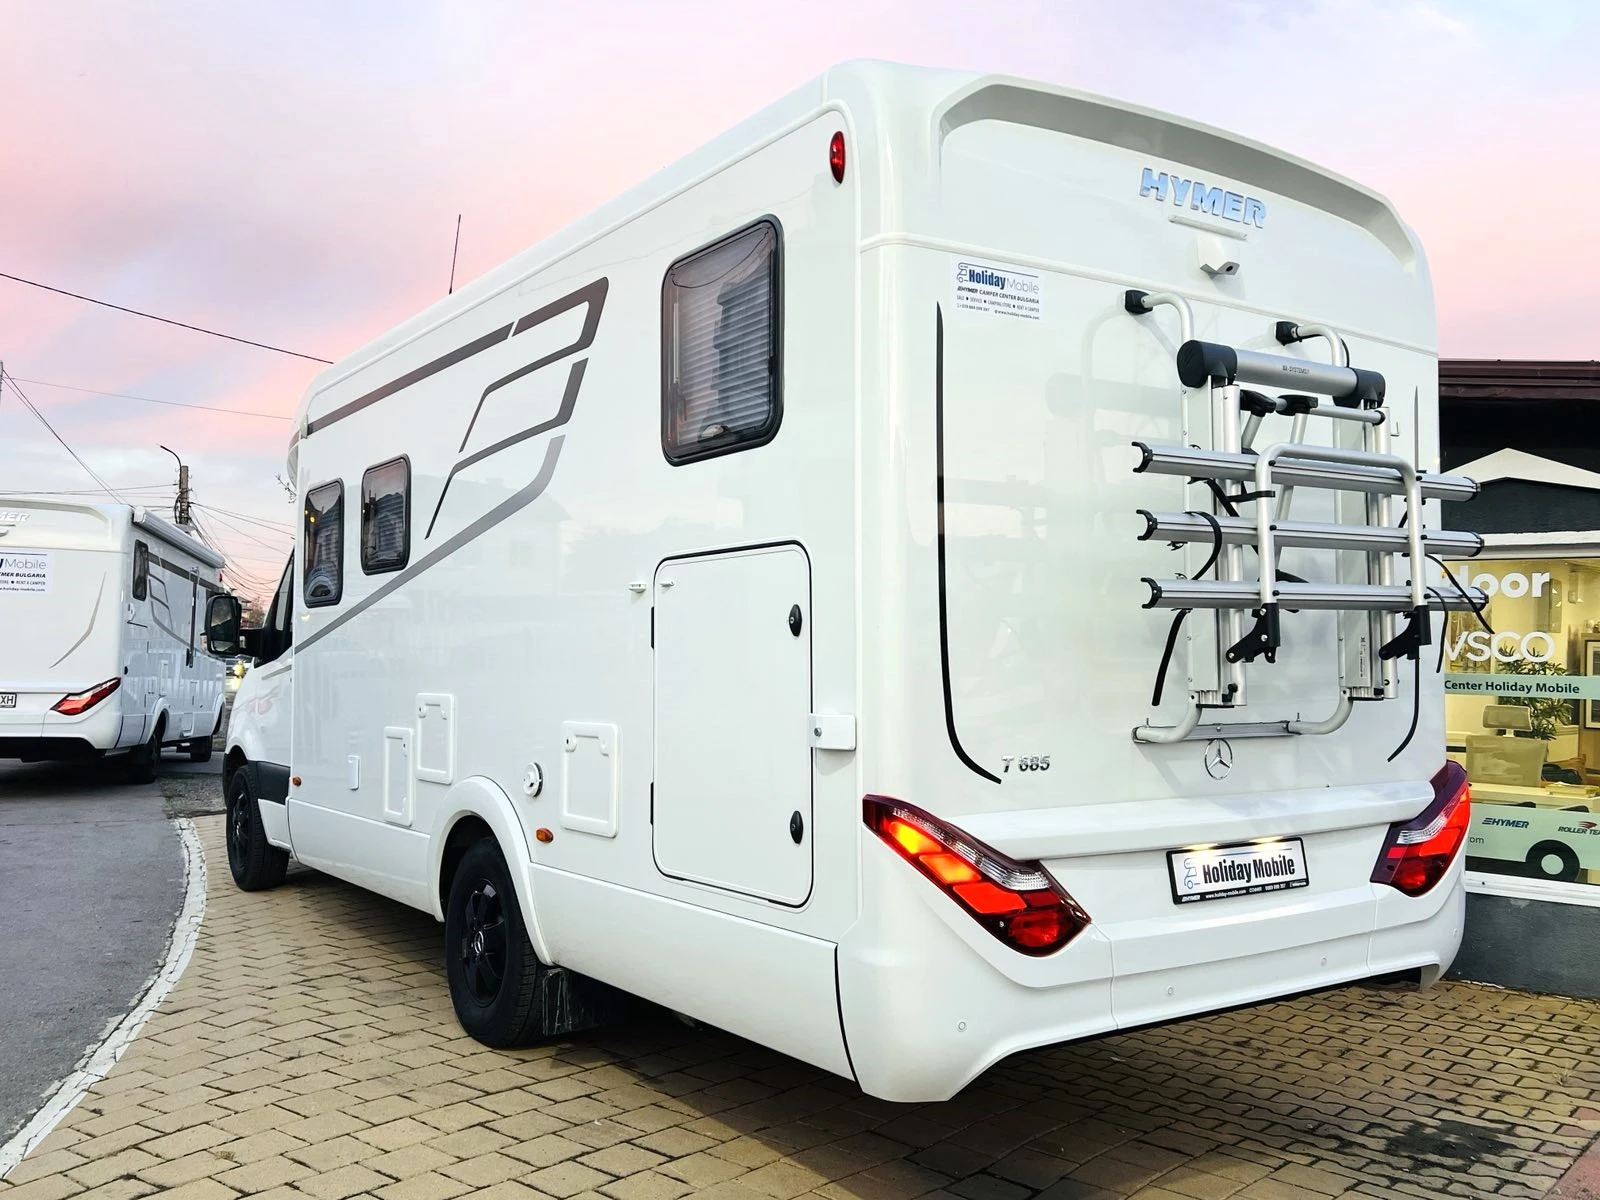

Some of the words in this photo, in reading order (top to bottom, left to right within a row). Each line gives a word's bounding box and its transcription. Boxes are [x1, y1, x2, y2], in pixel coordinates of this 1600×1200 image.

[1139, 167, 1267, 229] HYMER
[968, 269, 1006, 290] Holiday
[1006, 278, 1040, 294] Mobile
[979, 289, 999, 298] CAMPER
[999, 293, 1017, 301] CENTER
[1017, 296, 1040, 304] BULGARIA
[5, 558, 46, 570] Mobile
[1444, 680, 1483, 691] Center
[1485, 681, 1533, 695] Holiday
[1536, 683, 1581, 694] Mobile
[1001, 756, 1015, 773] T
[1019, 754, 1050, 772] 685
[1490, 818, 1530, 829] HYMER
[1558, 825, 1588, 834] ROLLER
[1468, 836, 1484, 844] om
[1202, 859, 1252, 884] Holiday
[1252, 854, 1296, 879] Mobile
